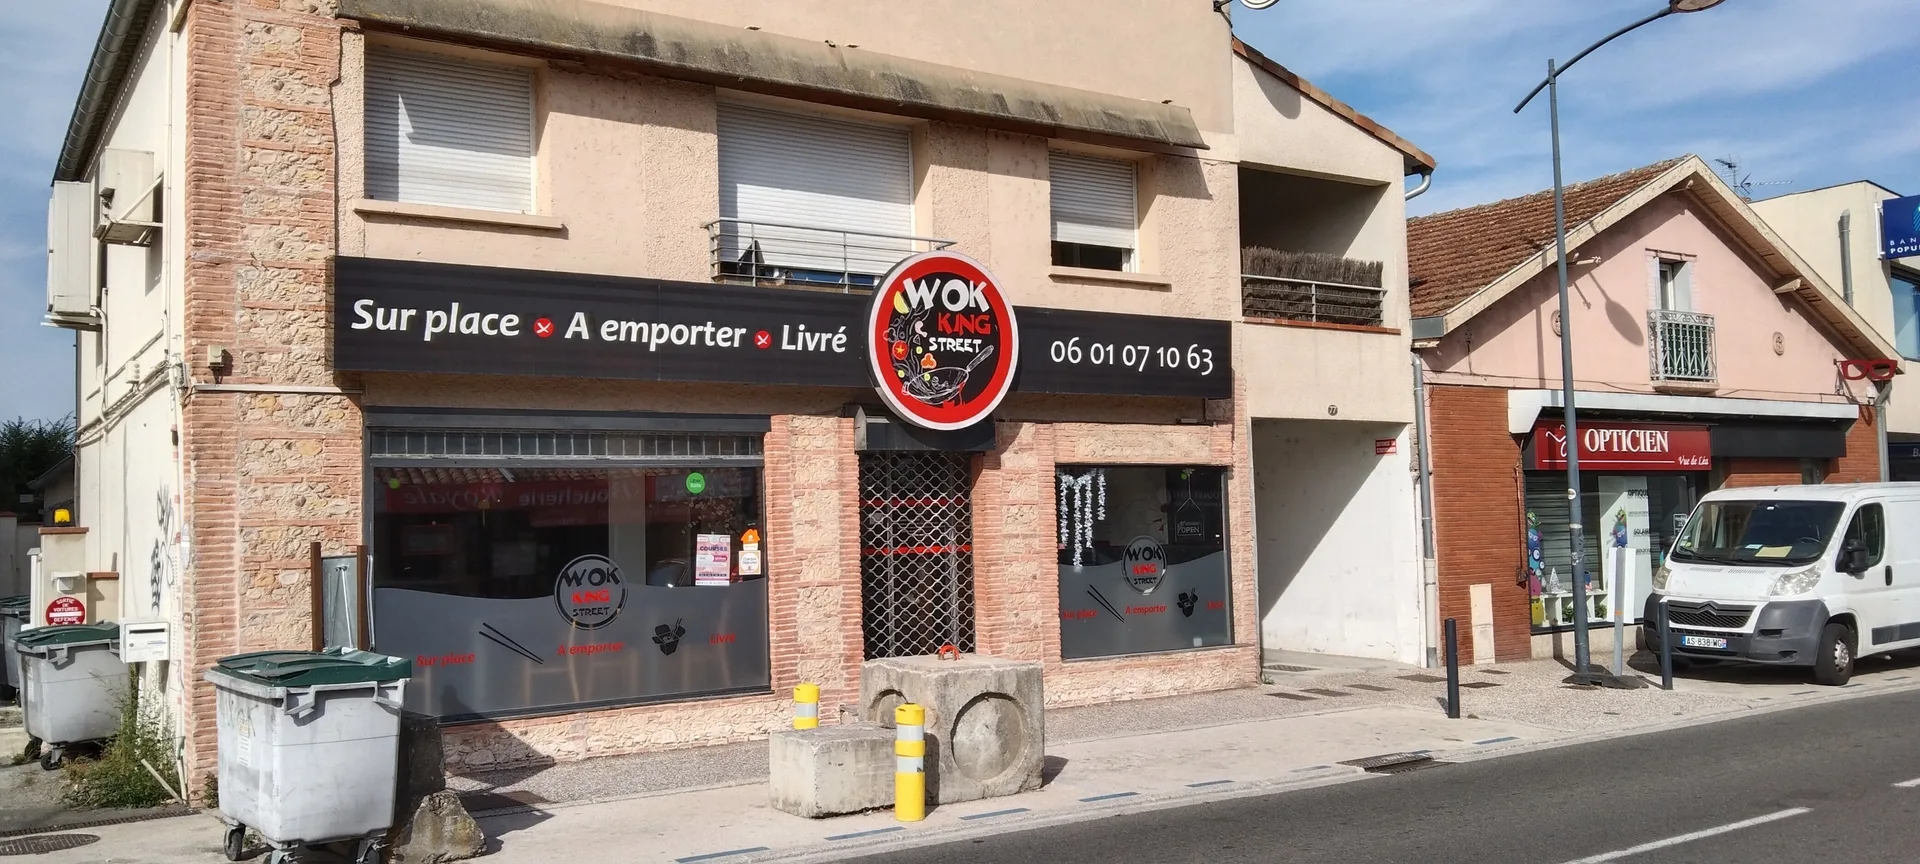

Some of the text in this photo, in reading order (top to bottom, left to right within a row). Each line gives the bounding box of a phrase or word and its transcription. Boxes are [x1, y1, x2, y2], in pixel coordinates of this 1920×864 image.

[903, 278, 989, 311] WOK
[350, 298, 520, 341] Sur place
[937, 313, 991, 335] KING
[564, 311, 747, 352] A emporter
[781, 323, 847, 353] Livré
[928, 337, 983, 353] STREET
[1050, 336, 1214, 376] 06 01 07 10 63
[1584, 428, 1670, 453] OPTICIEN
[1678, 455, 1690, 466] Vue
[1690, 455, 1698, 466] de
[1125, 545, 1162, 561] WOK
[561, 567, 620, 587] WOK
[1134, 577, 1157, 585] STREET
[572, 590, 610, 604] KING
[572, 606, 610, 617] STREET
[1125, 604, 1168, 615] A emporter
[557, 641, 624, 656] A emporter
[416, 652, 476, 669] Sur place
